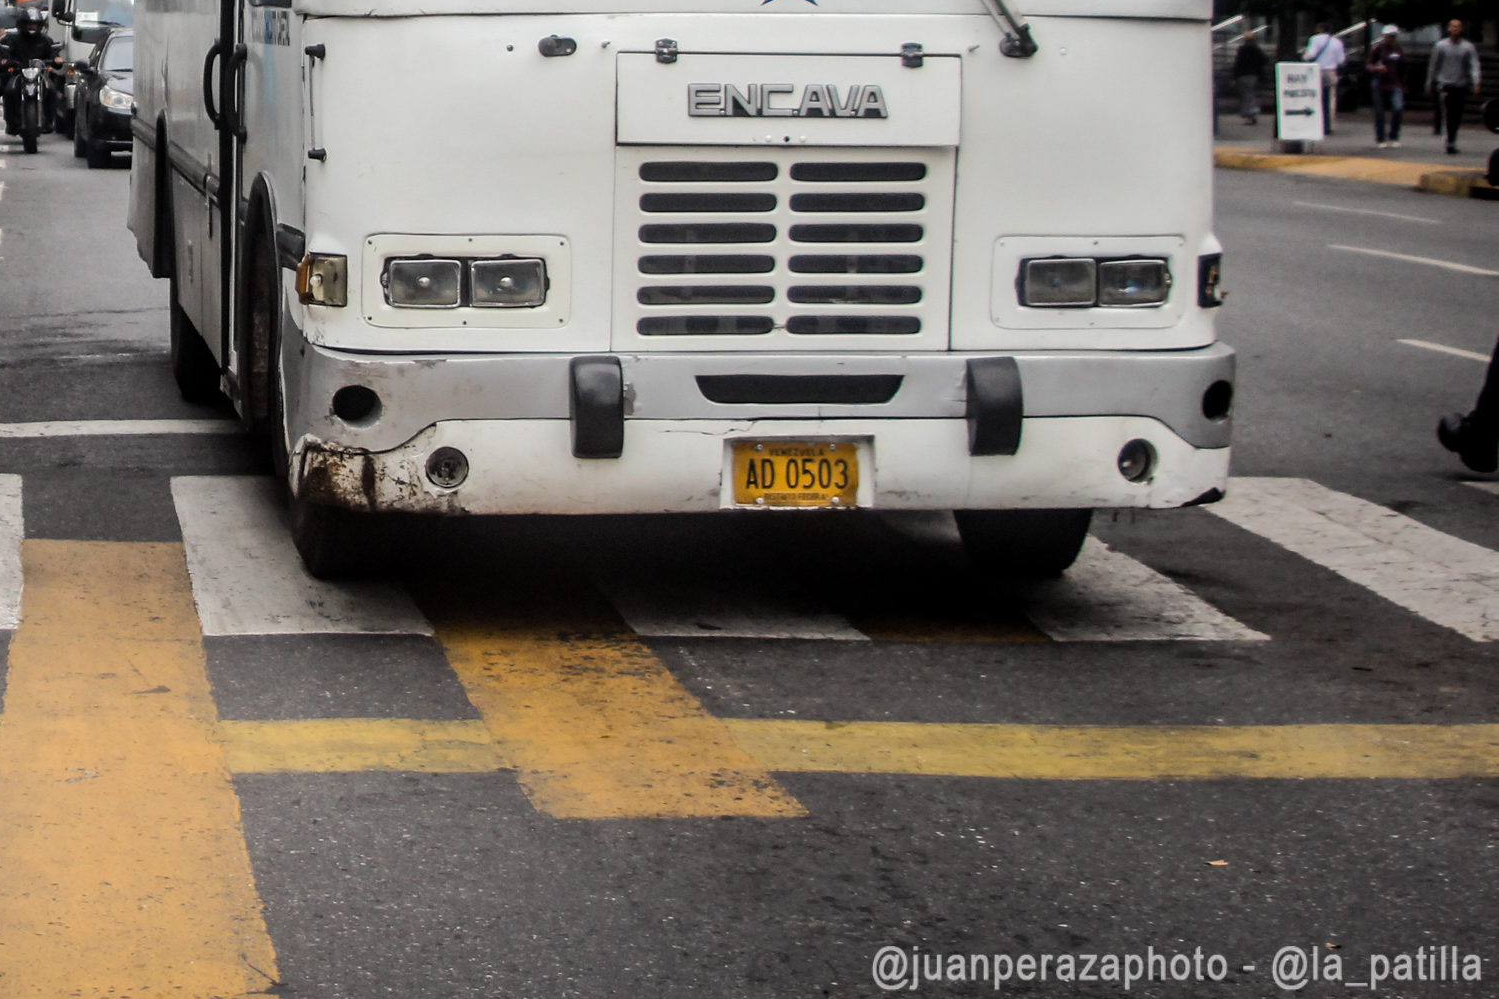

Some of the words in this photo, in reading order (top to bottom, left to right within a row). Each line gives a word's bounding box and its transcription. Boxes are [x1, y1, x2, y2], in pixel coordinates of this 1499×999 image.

[687, 83, 889, 119] ENCAVA
[768, 448, 825, 457] VENEZUELA
[745, 458, 776, 489] AD
[785, 458, 849, 489] 0503
